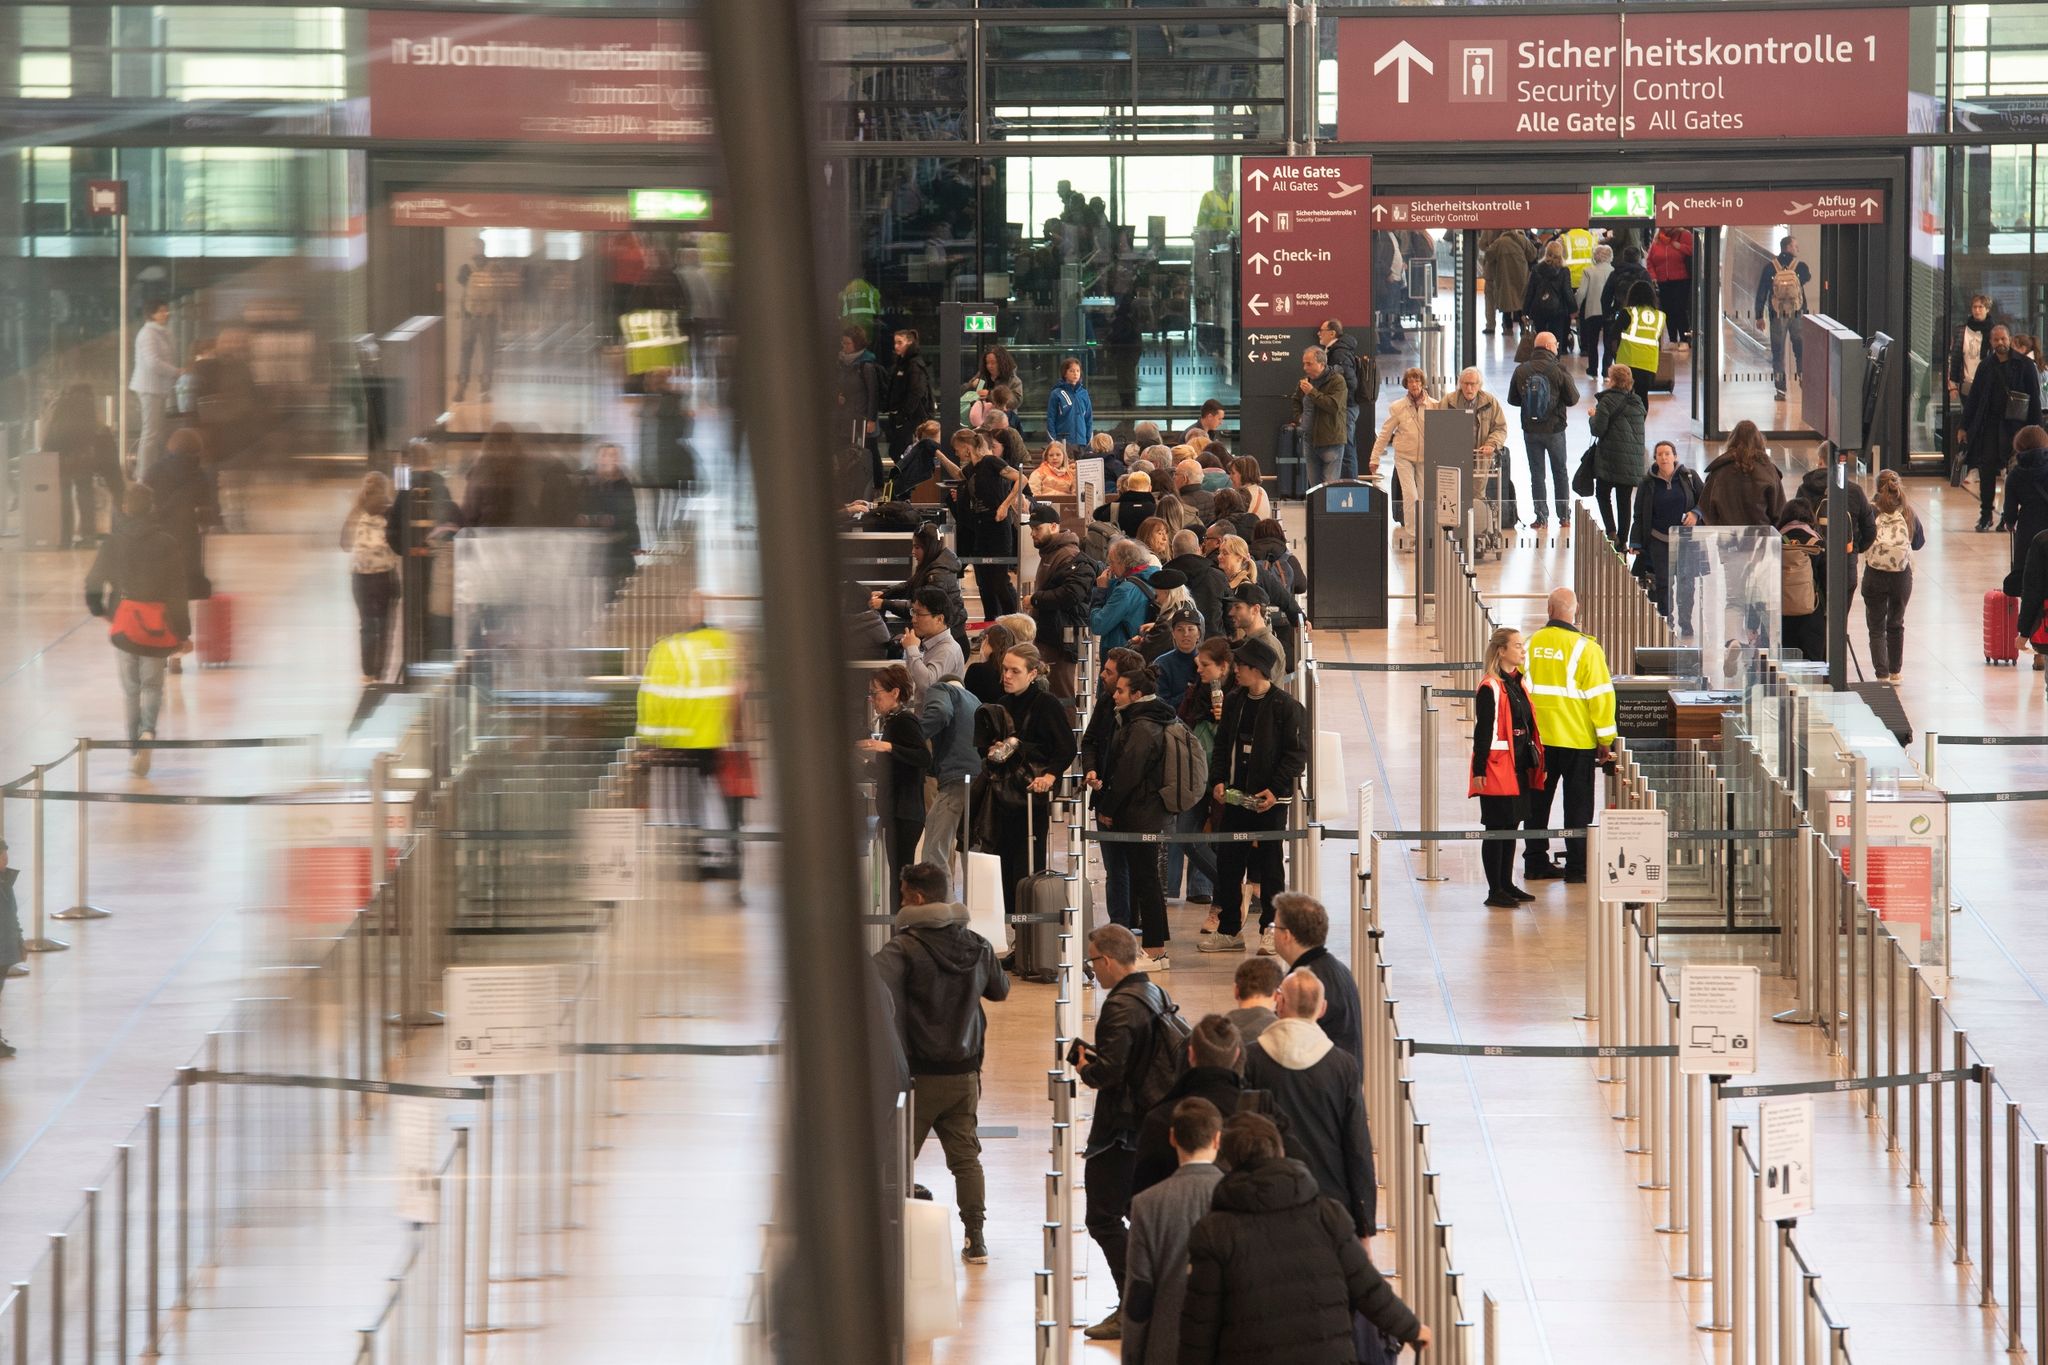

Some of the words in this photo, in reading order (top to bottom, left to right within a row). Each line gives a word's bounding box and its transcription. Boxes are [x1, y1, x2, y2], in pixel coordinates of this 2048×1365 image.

[1517, 34, 1853, 69] Sicherheitskontrolle
[1864, 35, 1877, 62] 1
[1517, 79, 1617, 108] Security
[1632, 76, 1725, 102] Control
[1516, 112, 1560, 133] Alle
[1566, 113, 1636, 132] Gates
[1649, 111, 1677, 131] All
[1684, 110, 1744, 130] Gates
[1273, 166, 1300, 178] Alle
[1303, 166, 1341, 178] Gates
[1273, 181, 1287, 191] All
[1289, 181, 1319, 191] Gates
[1411, 200, 1522, 211] Sicherheitskontrolle
[1525, 201, 1530, 211] 1
[1684, 197, 1733, 209] Check-in
[1736, 198, 1744, 208] 0
[1818, 195, 1856, 208] Abflug
[1411, 213, 1446, 224] Security
[1447, 213, 1479, 222] Control
[1813, 208, 1857, 218] Departure
[1273, 249, 1331, 261] Check-in
[1273, 264, 1282, 276] 0
[1533, 647, 1564, 661] ESA
[1619, 713, 1644, 721] Dispose
[1233, 832, 1248, 840] BER
[1465, 831, 1480, 839] BER
[1558, 830, 1573, 838] BER
[1758, 830, 1774, 838] BER
[1011, 914, 1027, 923] BER
[1484, 1046, 1503, 1056] BER
[1598, 1047, 1617, 1057] BER
[1927, 1071, 1942, 1082] BER
[1835, 1080, 1850, 1091] BER
[1742, 1087, 1758, 1097] BER
